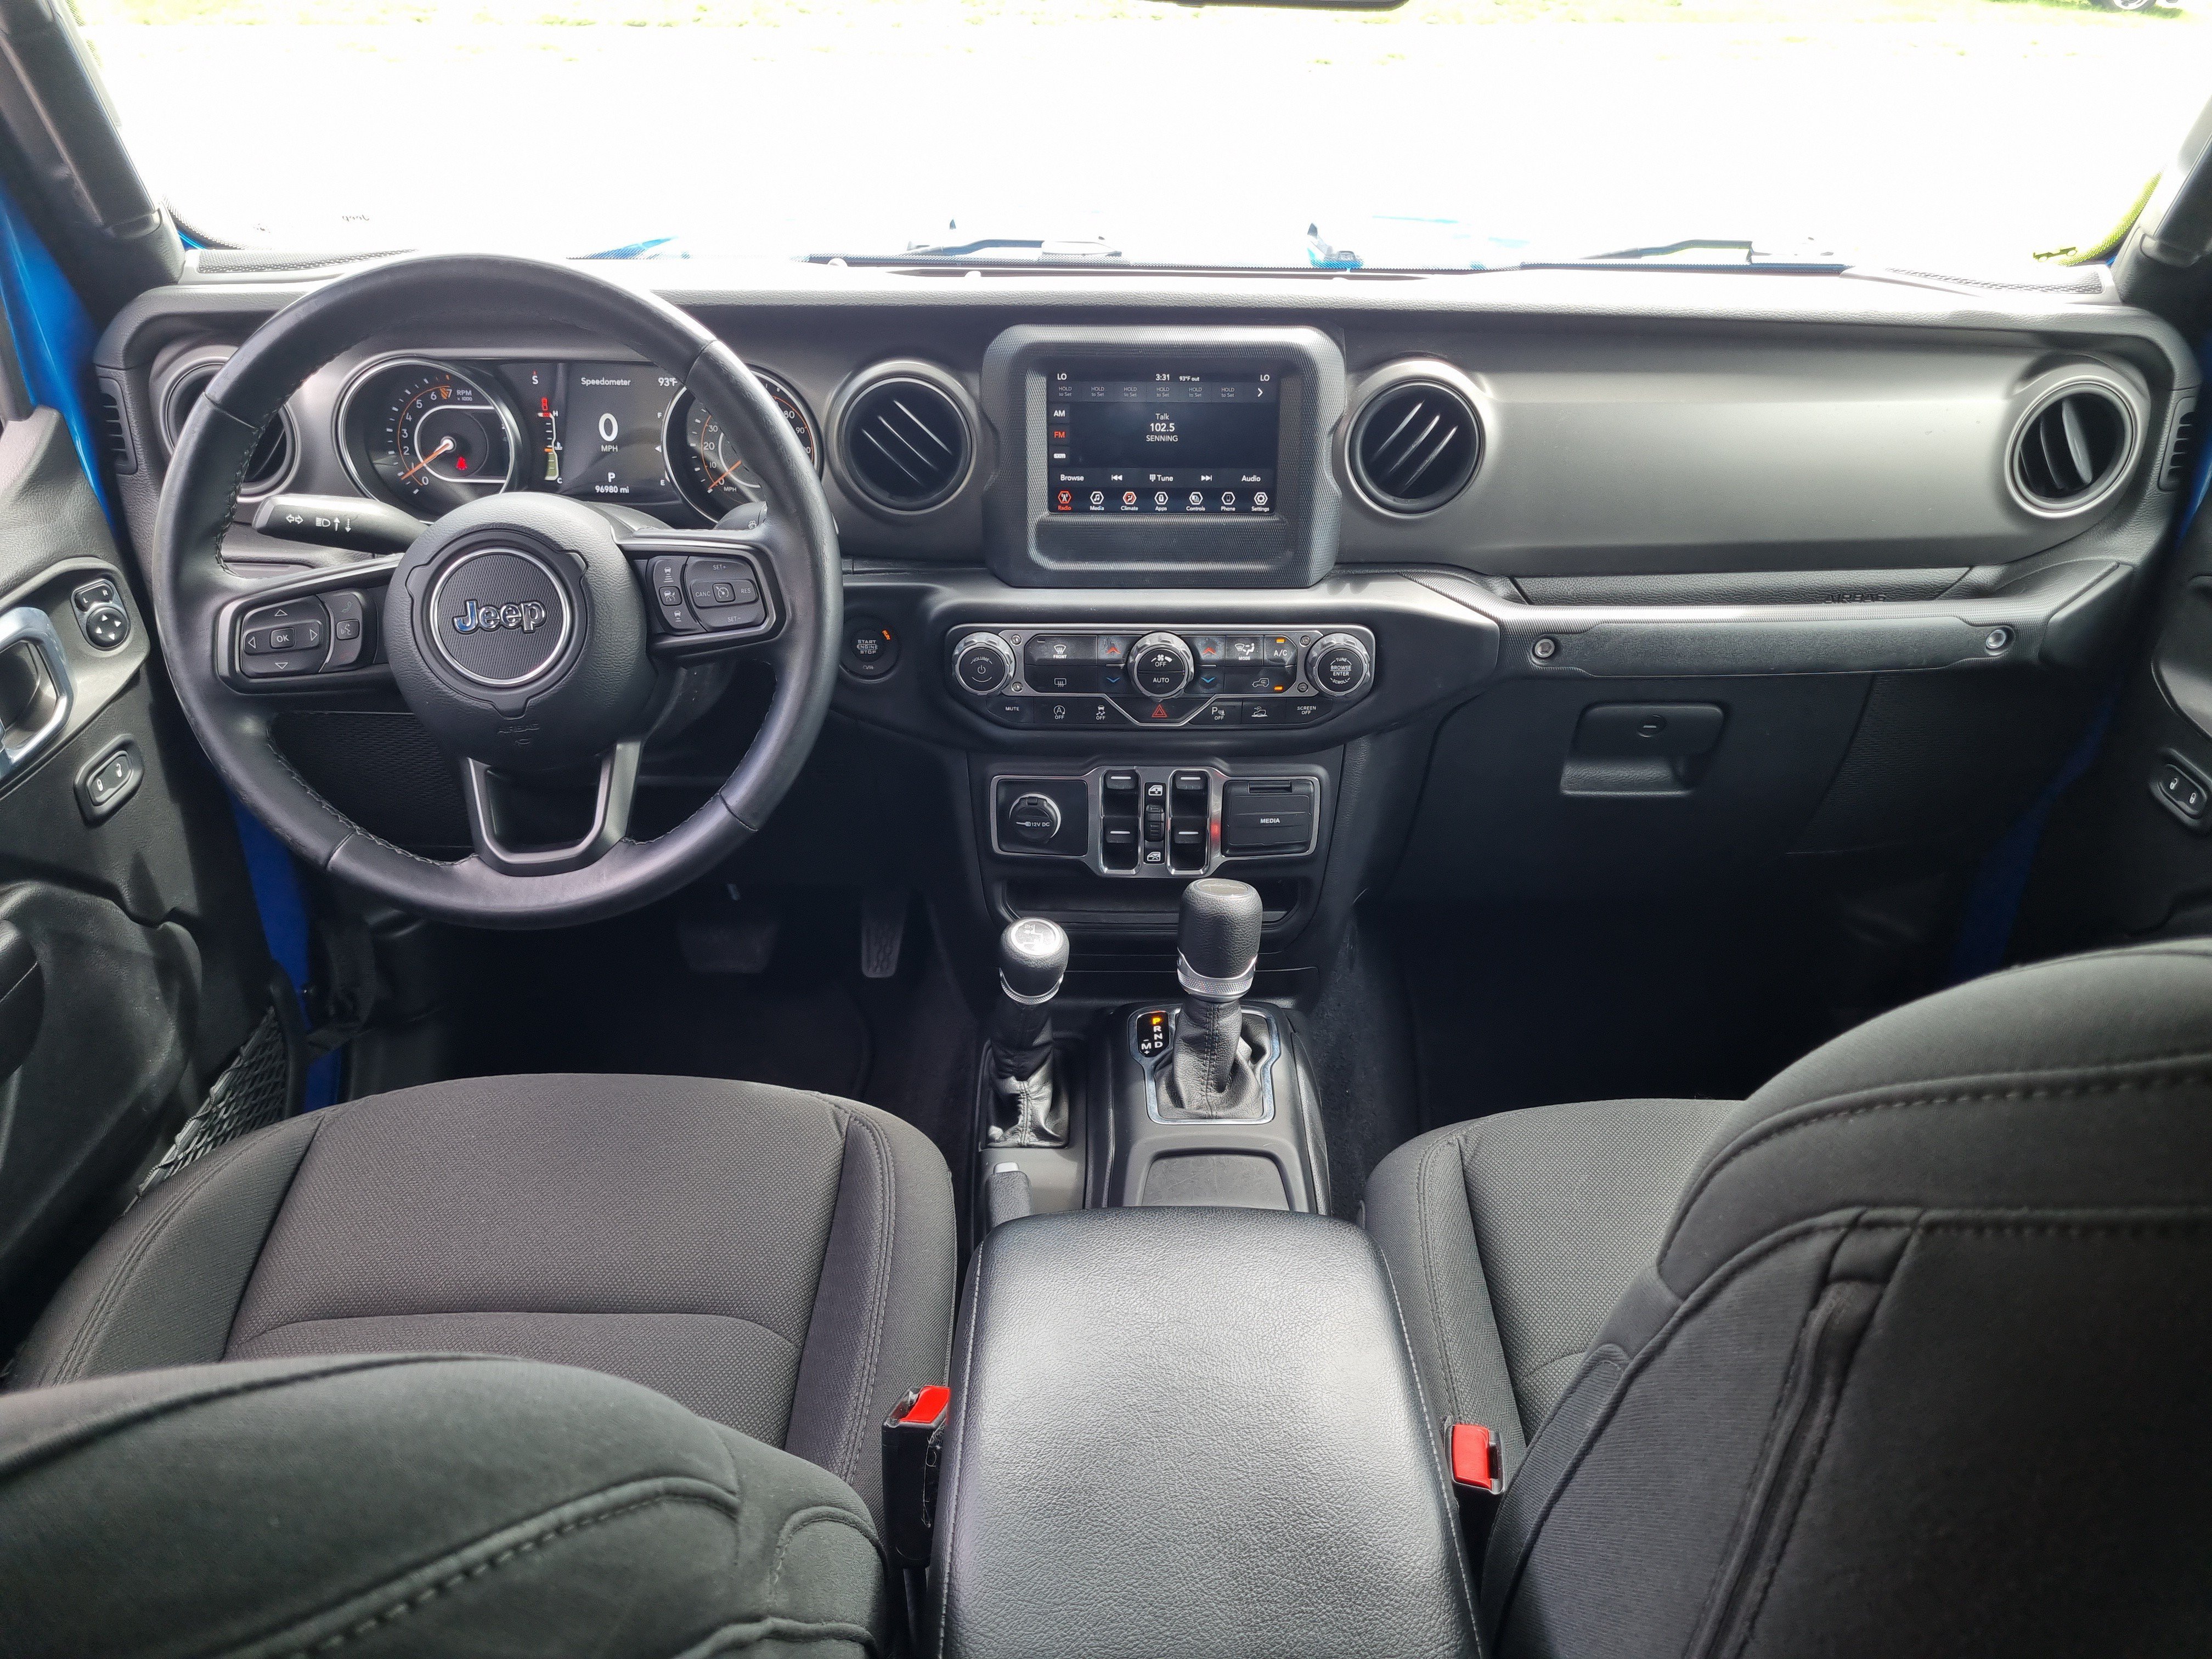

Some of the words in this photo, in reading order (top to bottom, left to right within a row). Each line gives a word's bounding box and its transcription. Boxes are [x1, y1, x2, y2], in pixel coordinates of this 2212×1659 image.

[532, 375, 539, 385] S
[581, 376, 631, 386] Speedometer
[658, 377, 678, 387] 93°F
[431, 392, 437, 400] 6
[447, 389, 453, 398] 7
[416, 399, 423, 409] 5
[405, 413, 412, 421] 4
[599, 413, 618, 442] 0
[1150, 423, 1175, 432] 102.5
[402, 428, 408, 438] 3
[404, 446, 410, 455] 2
[703, 442, 715, 450] 20
[421, 476, 429, 486] 0
[608, 472, 616, 483] P
[453, 600, 546, 633] Jeep
[276, 634, 290, 643] OK
